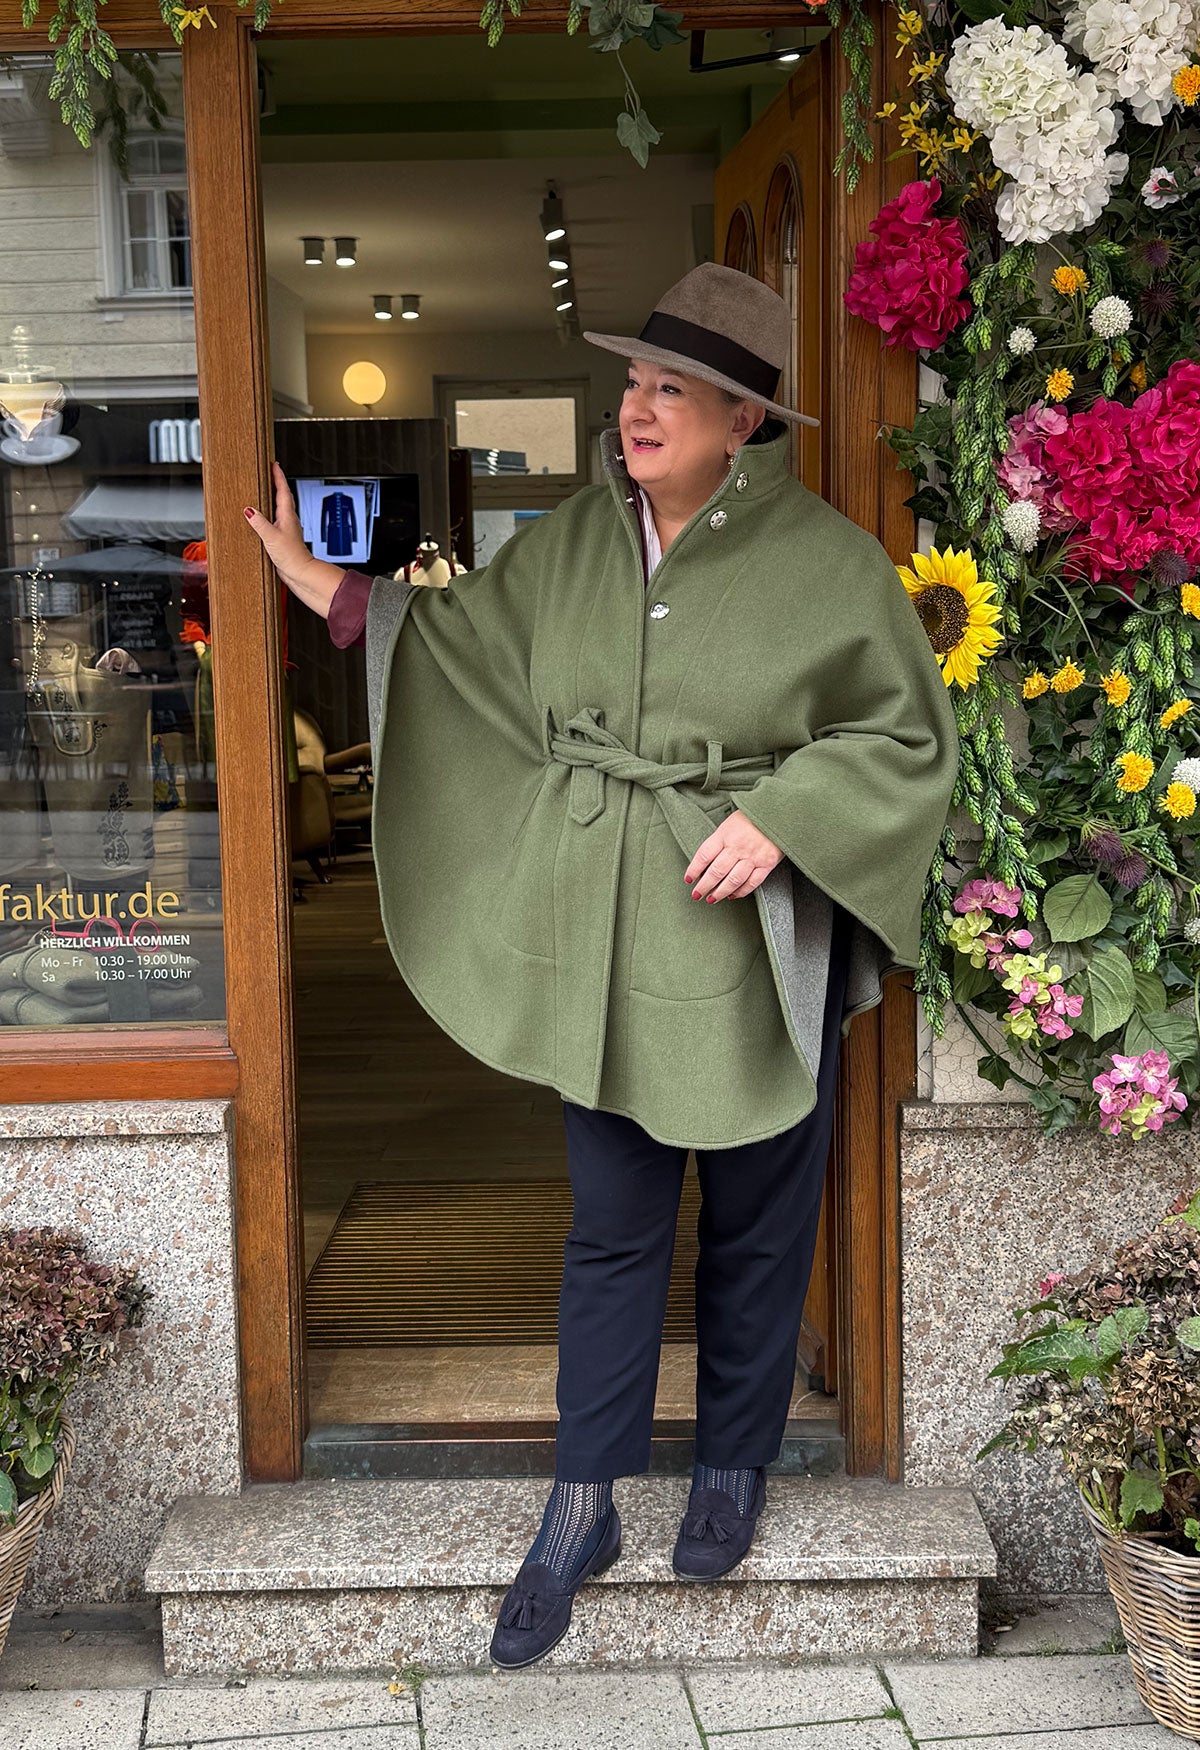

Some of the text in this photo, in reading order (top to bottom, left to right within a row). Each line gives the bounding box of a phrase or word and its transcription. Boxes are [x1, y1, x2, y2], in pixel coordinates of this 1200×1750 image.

[40, 935, 190, 949] HERZLICH WILLKOMMEN
[41, 957, 60, 968] Mo
[72, 956, 84, 967] Fr
[94, 955, 125, 966] 10.30
[137, 954, 167, 965] 19.00
[170, 954, 191, 965] Uhr
[42, 971, 56, 982] Sa
[95, 970, 125, 981] 10.30
[138, 969, 168, 980] 17.00
[171, 968, 192, 979] Uhr
